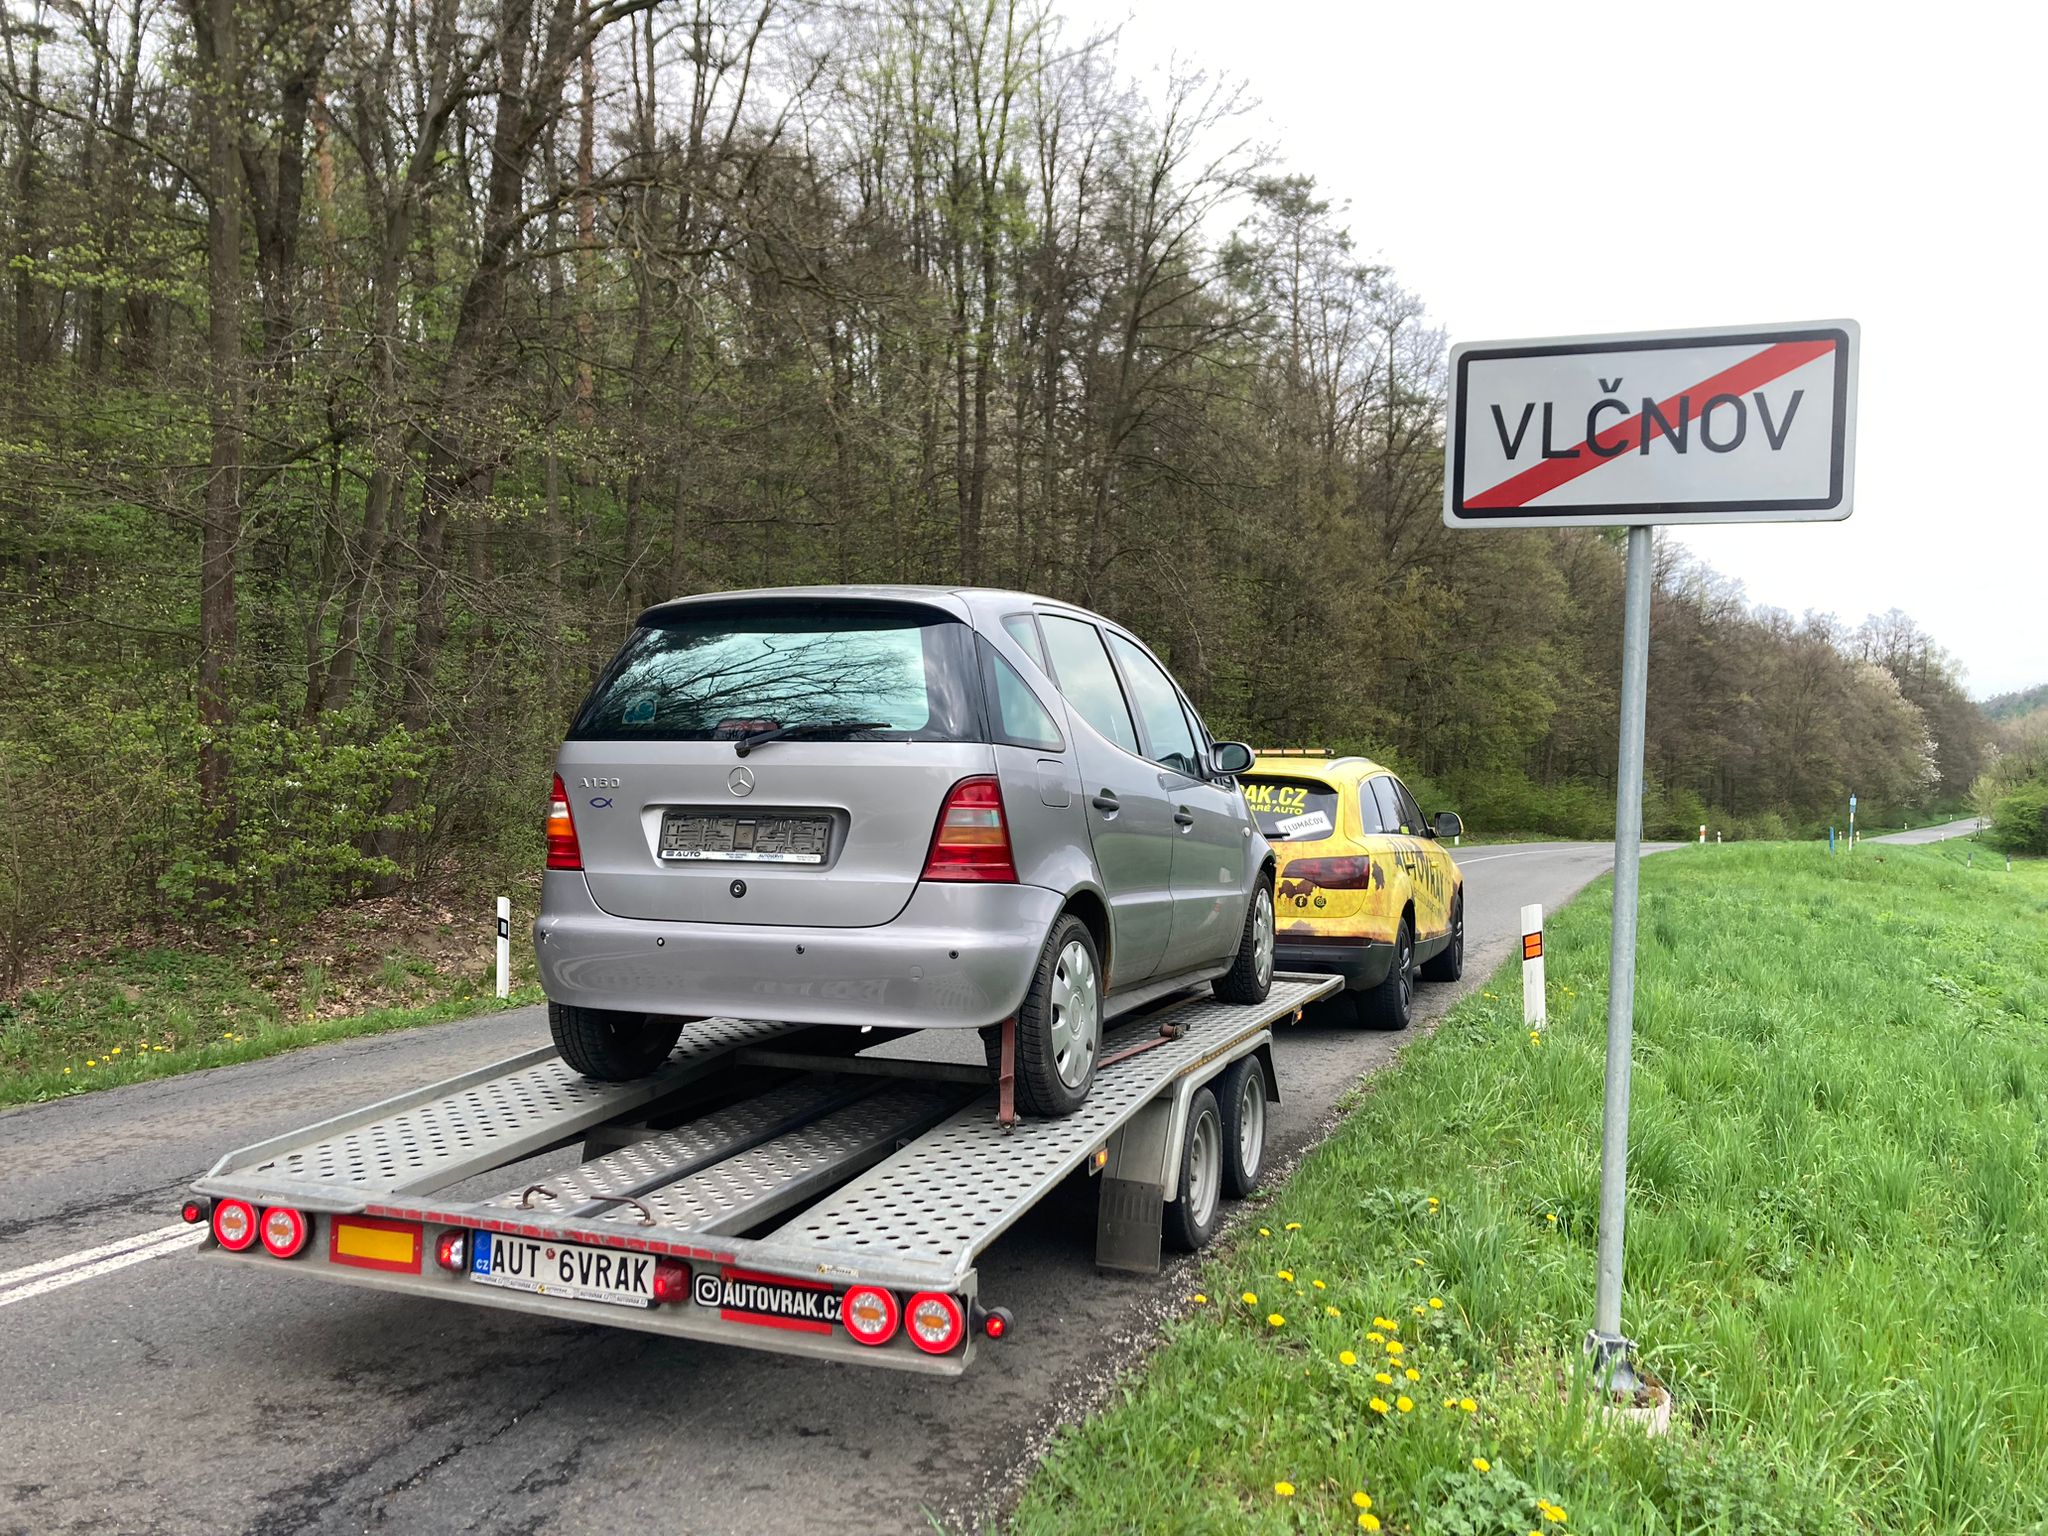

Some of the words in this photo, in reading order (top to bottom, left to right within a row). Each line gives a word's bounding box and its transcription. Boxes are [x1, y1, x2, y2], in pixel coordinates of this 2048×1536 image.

[1490, 378, 1805, 460] VLČNOV
[1273, 805, 1303, 816] AUTO
[476, 1260, 490, 1272] CZ
[492, 1239, 541, 1278] AUT
[559, 1249, 650, 1294] 6VRAK
